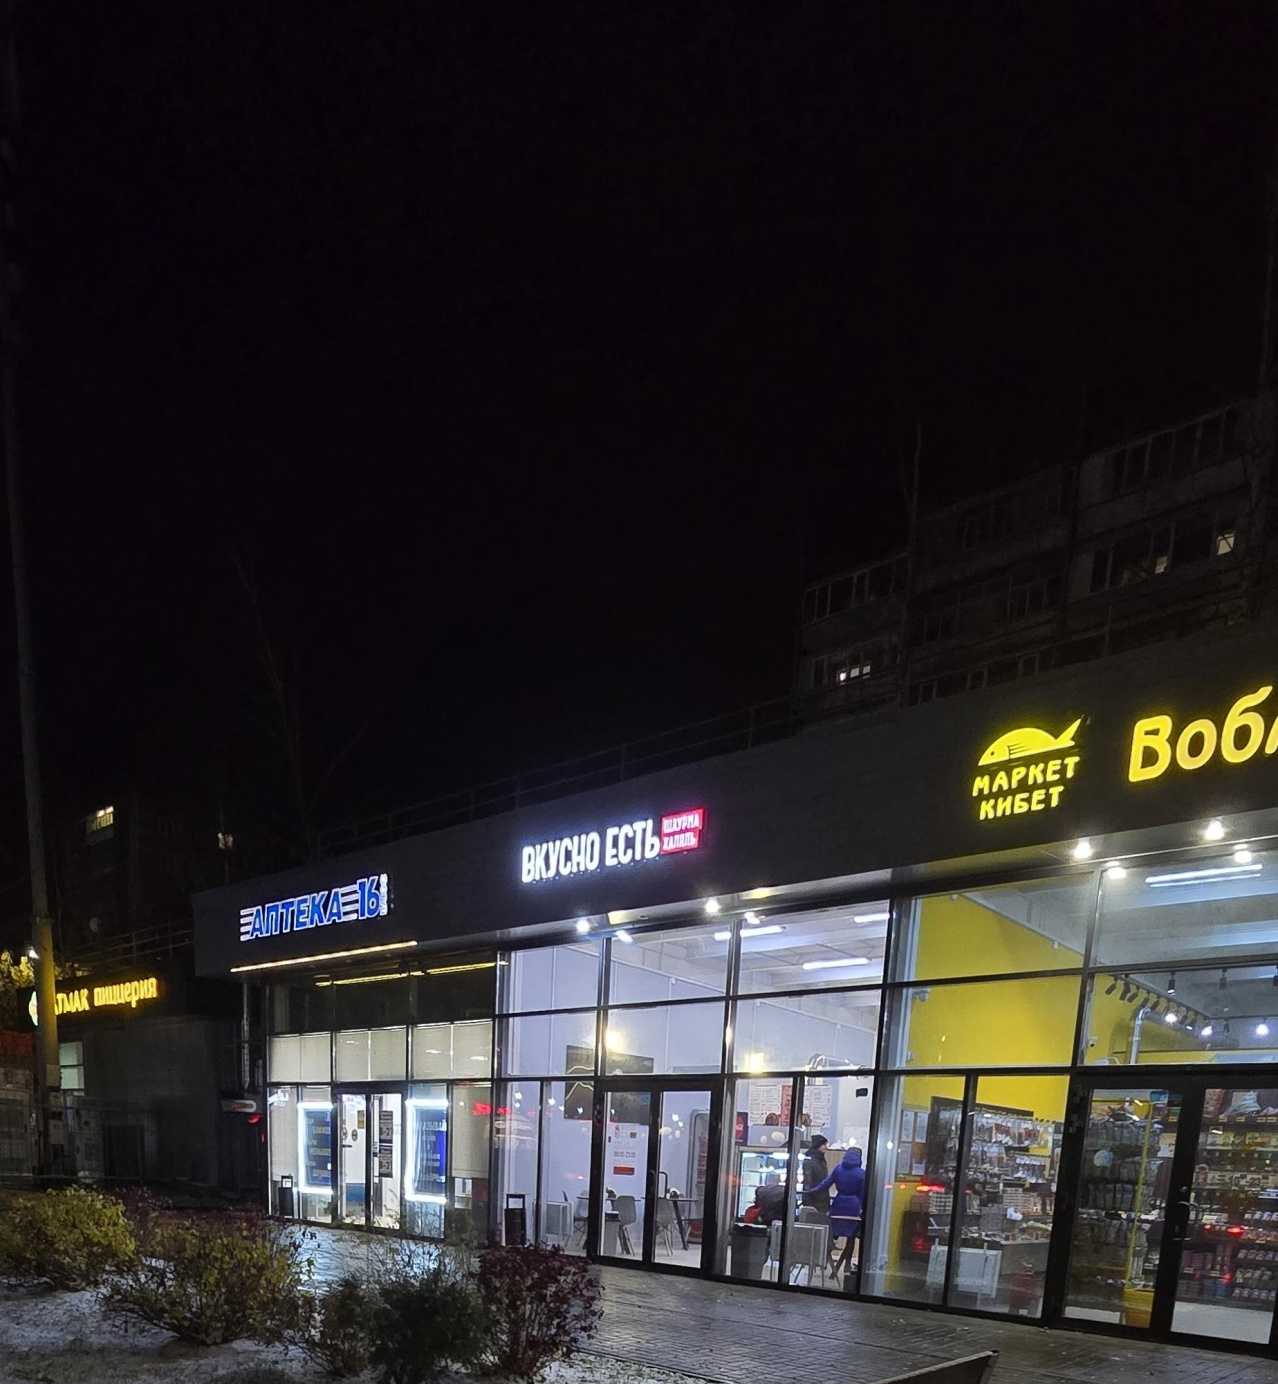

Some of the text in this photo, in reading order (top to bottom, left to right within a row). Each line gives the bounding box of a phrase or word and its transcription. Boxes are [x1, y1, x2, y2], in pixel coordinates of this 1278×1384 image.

[972, 756, 1080, 796] МАРКЕТ
[979, 786, 1064, 820] КИБЕТ
[663, 814, 699, 833] ШАУРМА
[521, 819, 660, 883] ВКУСНО ЕСТЬ
[250, 888, 343, 939] АПТЕКА
[357, 876, 380, 920] 16
[93, 977, 157, 1008] пиццерия
